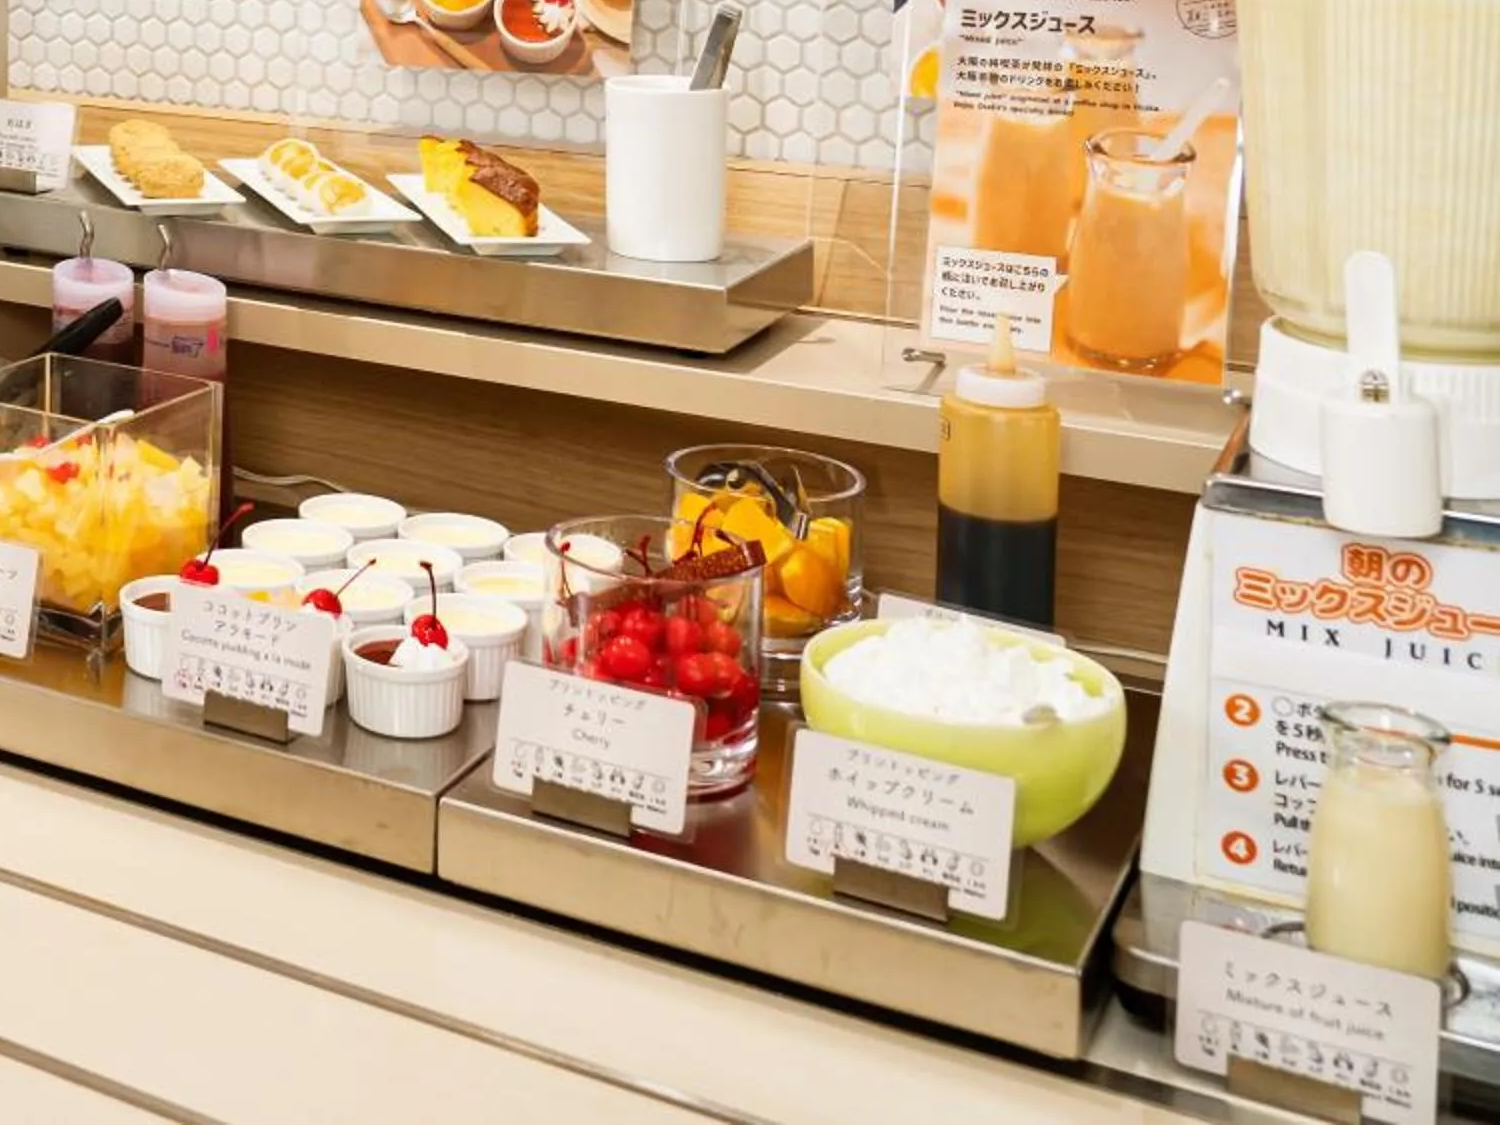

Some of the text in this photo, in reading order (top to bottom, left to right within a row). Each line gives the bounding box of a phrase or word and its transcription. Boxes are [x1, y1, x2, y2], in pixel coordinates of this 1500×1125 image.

[960, 7, 1096, 34] ミックスジュース
[1341, 543, 1433, 592] 朝の
[1267, 619, 1341, 648] MIX
[1276, 741, 1317, 762] Press
[1447, 772, 1470, 790] for
[846, 796, 905, 823] Whipped
[1224, 960, 1393, 1019] ミックスジュース
